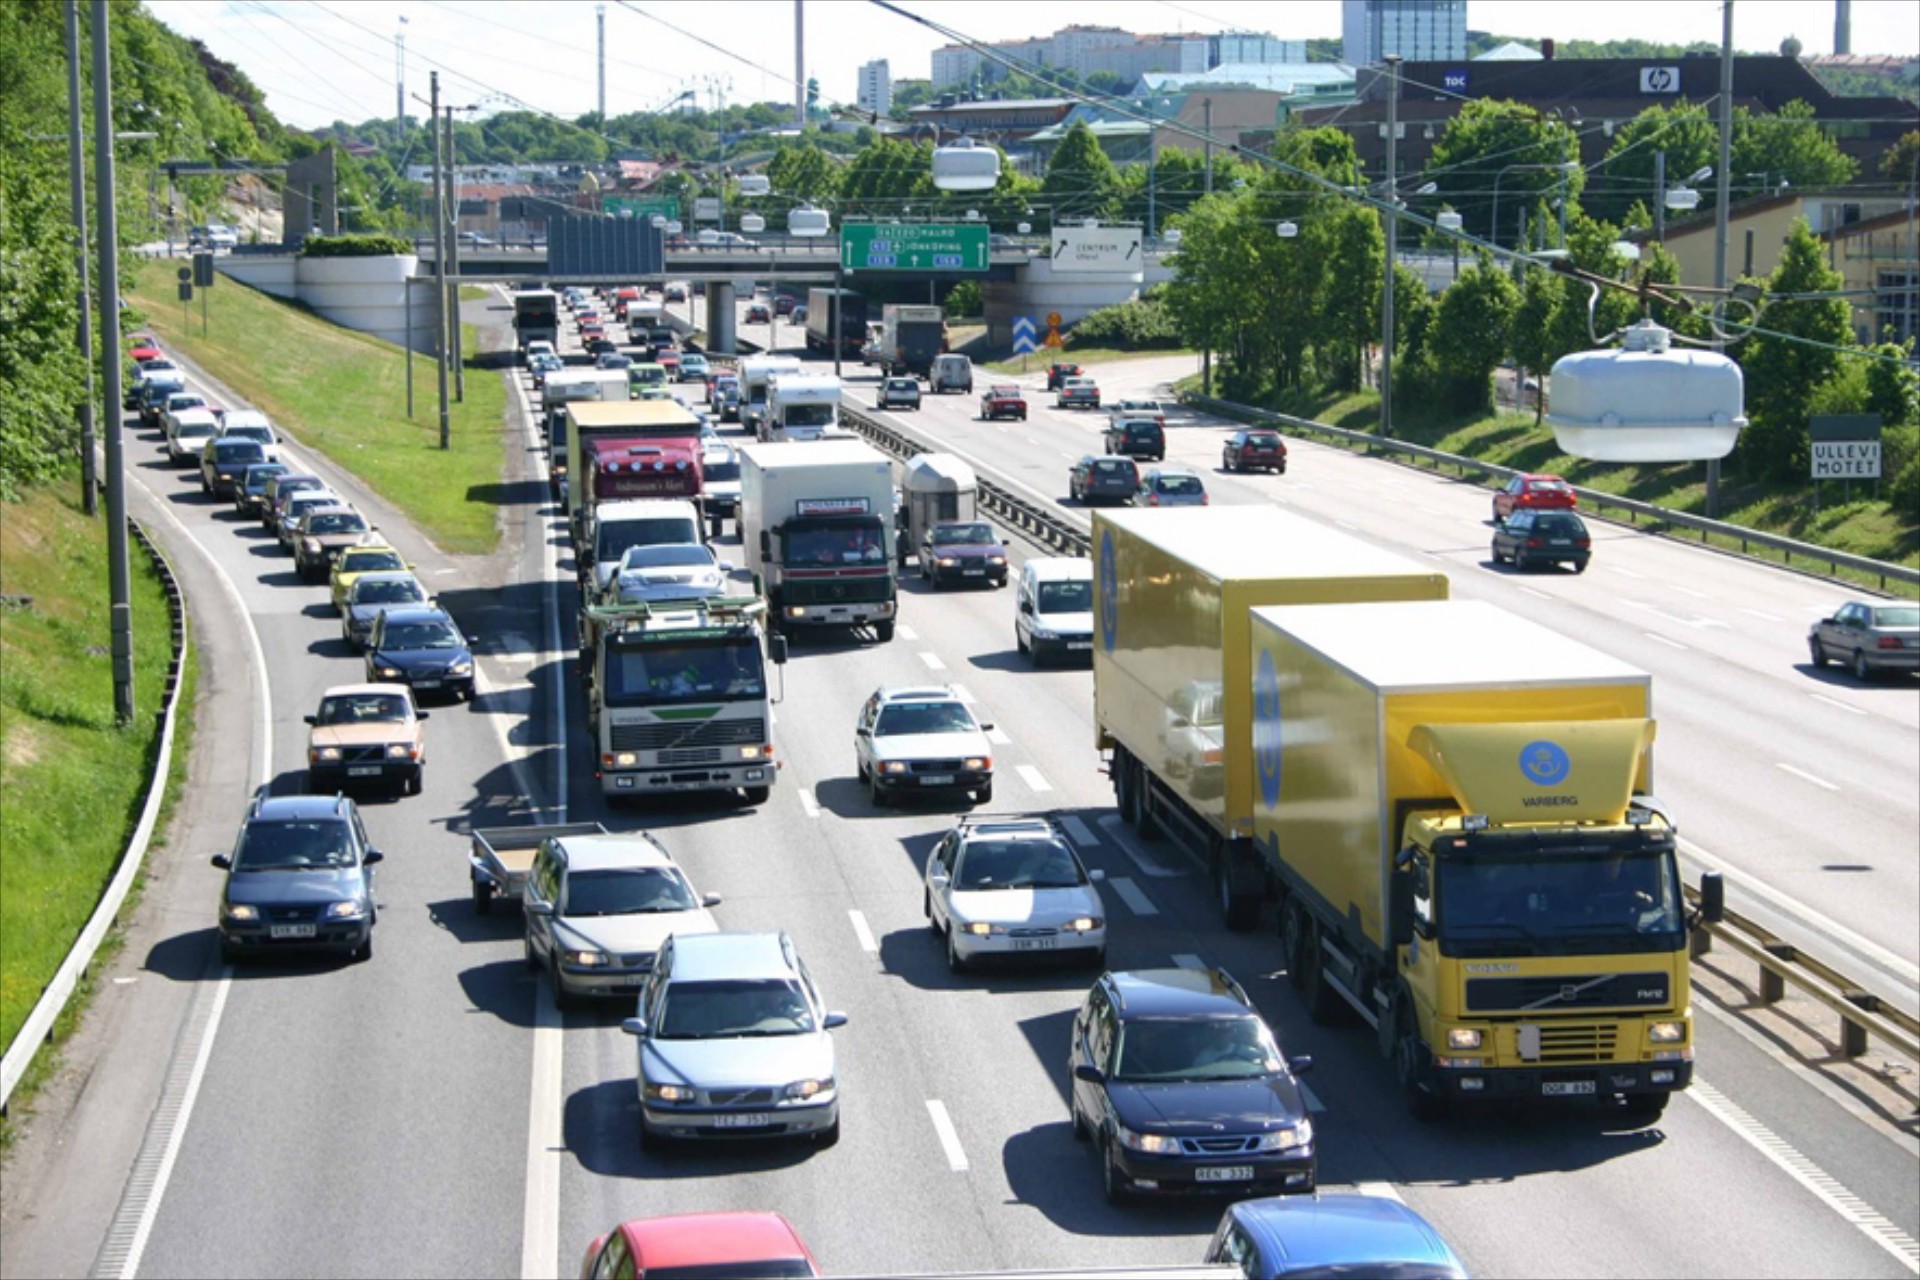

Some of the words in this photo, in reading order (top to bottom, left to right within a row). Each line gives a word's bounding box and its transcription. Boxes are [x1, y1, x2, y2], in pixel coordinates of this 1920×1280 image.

[1815, 445, 1878, 458] ULLEVI
[1817, 461, 1875, 474] MOTET
[1522, 795, 1579, 808] VARBERG
